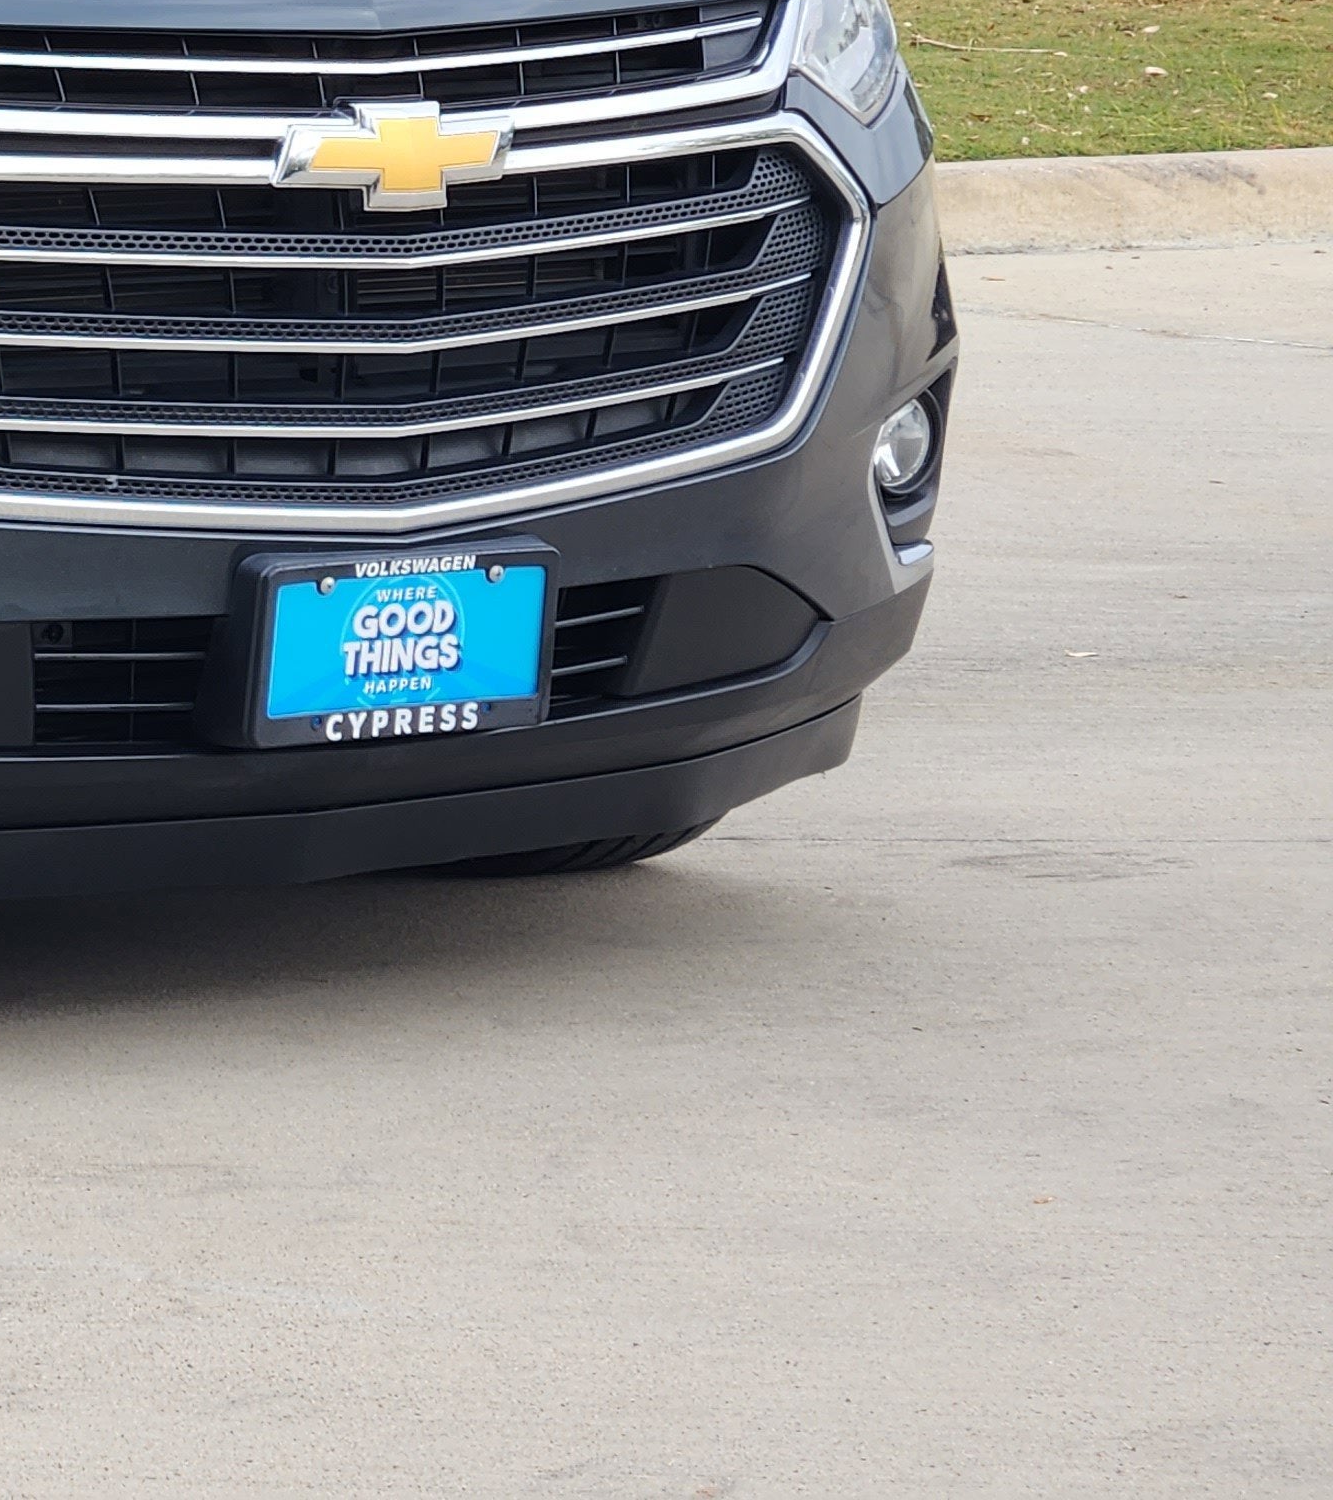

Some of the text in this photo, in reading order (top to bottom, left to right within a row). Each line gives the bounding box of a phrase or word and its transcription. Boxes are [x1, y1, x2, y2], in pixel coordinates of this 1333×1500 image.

[354, 555, 477, 579] VOLKSWAGEN
[376, 586, 438, 603] WHERE
[352, 600, 457, 640] GOOD
[343, 636, 460, 677] THINGS
[362, 677, 433, 695] HAPPEN
[325, 701, 480, 743] CYPRESS
